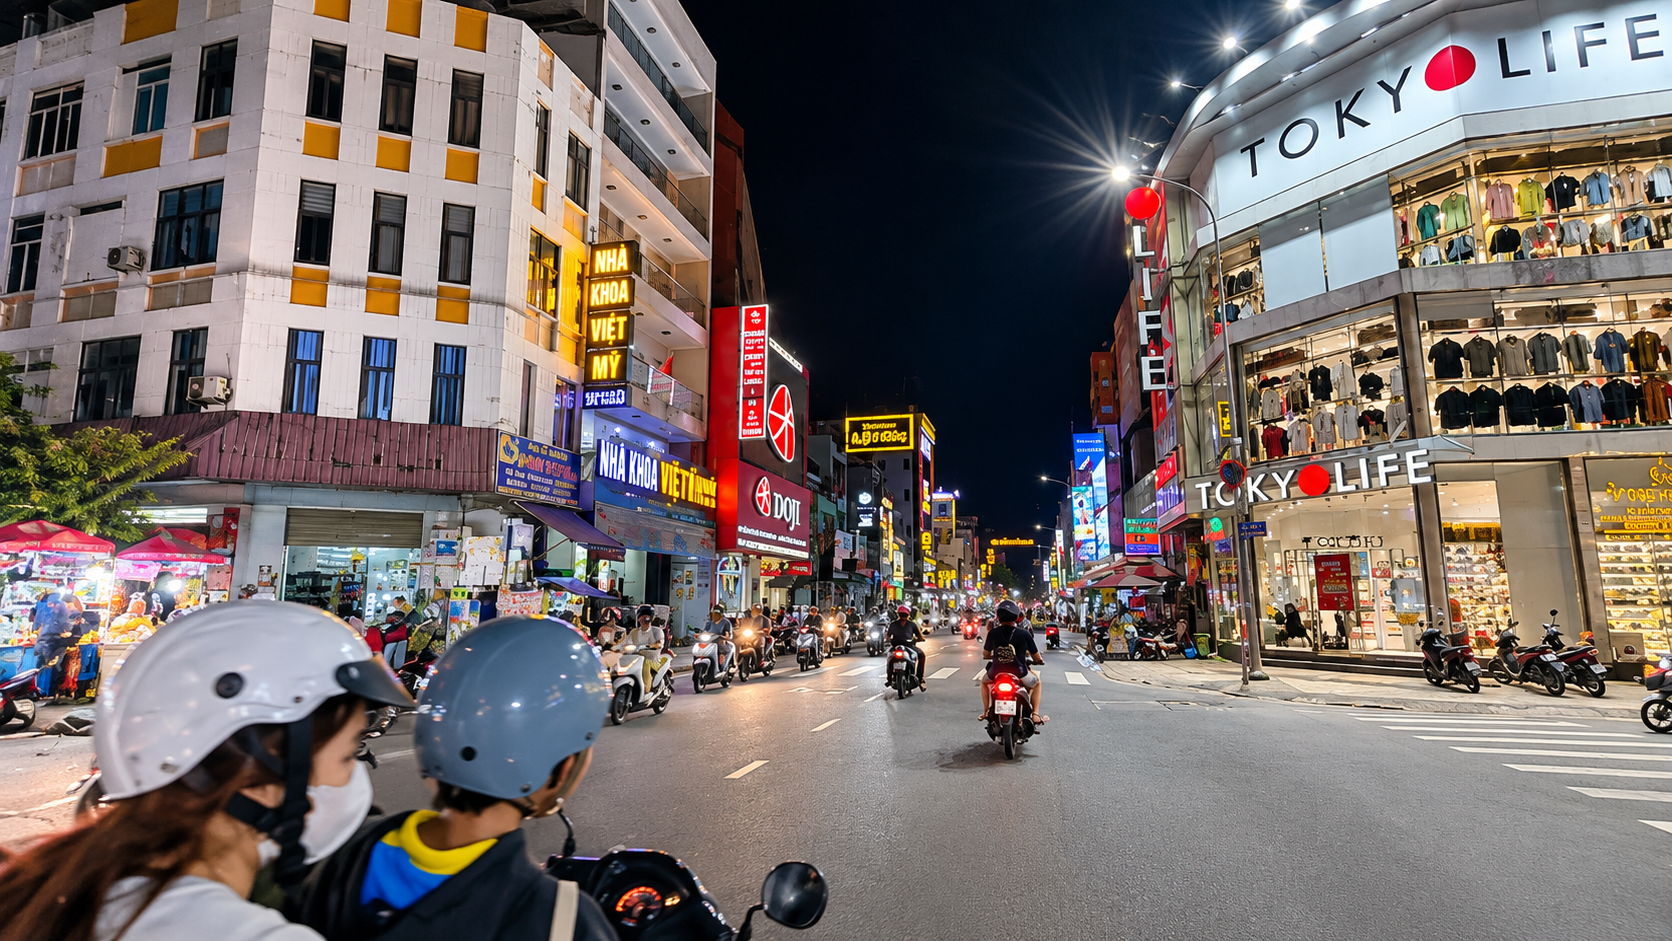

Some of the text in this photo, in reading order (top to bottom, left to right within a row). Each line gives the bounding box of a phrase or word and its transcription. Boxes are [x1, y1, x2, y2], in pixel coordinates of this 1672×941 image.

[1496, 13, 1665, 79] LIFE
[590, 279, 630, 307] KHOA
[628, 449, 658, 492] KHOA
[1334, 448, 1433, 493] LIFE
[773, 492, 802, 532] DOJI
